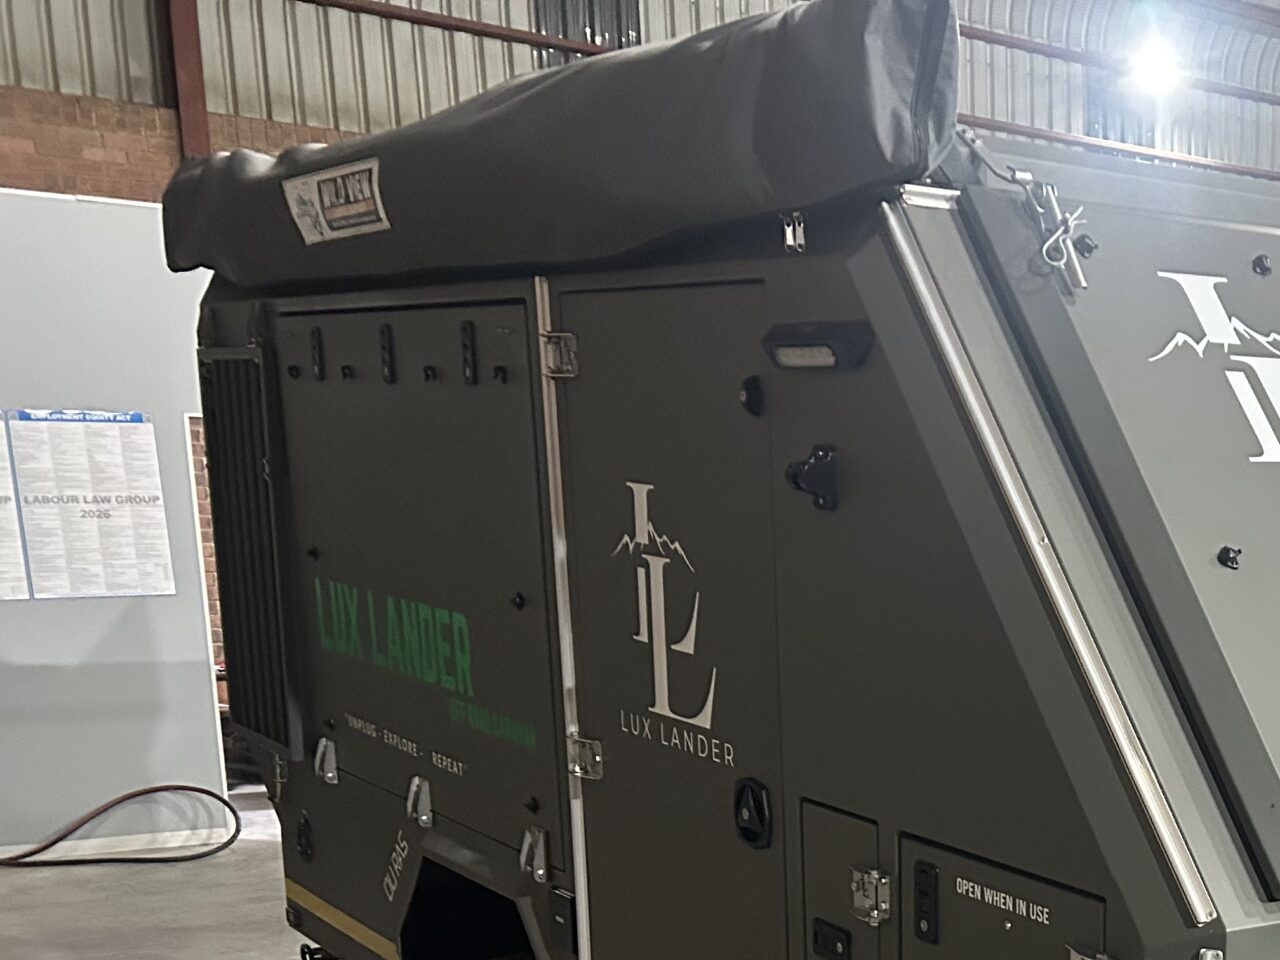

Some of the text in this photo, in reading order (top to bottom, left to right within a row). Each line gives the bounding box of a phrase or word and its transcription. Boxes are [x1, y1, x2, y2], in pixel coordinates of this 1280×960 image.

[23, 495, 81, 505] LABOUR
[82, 495, 111, 505] LAW
[114, 495, 161, 505] GROUP
[80, 509, 112, 519] 2026
[314, 576, 475, 698] LUX LANDER
[383, 728, 419, 757] EXPLORE
[619, 708, 735, 768] LUX LANDER
[382, 828, 409, 903] DURAS
[955, 876, 1050, 926] OPEN WHEN IN USE
